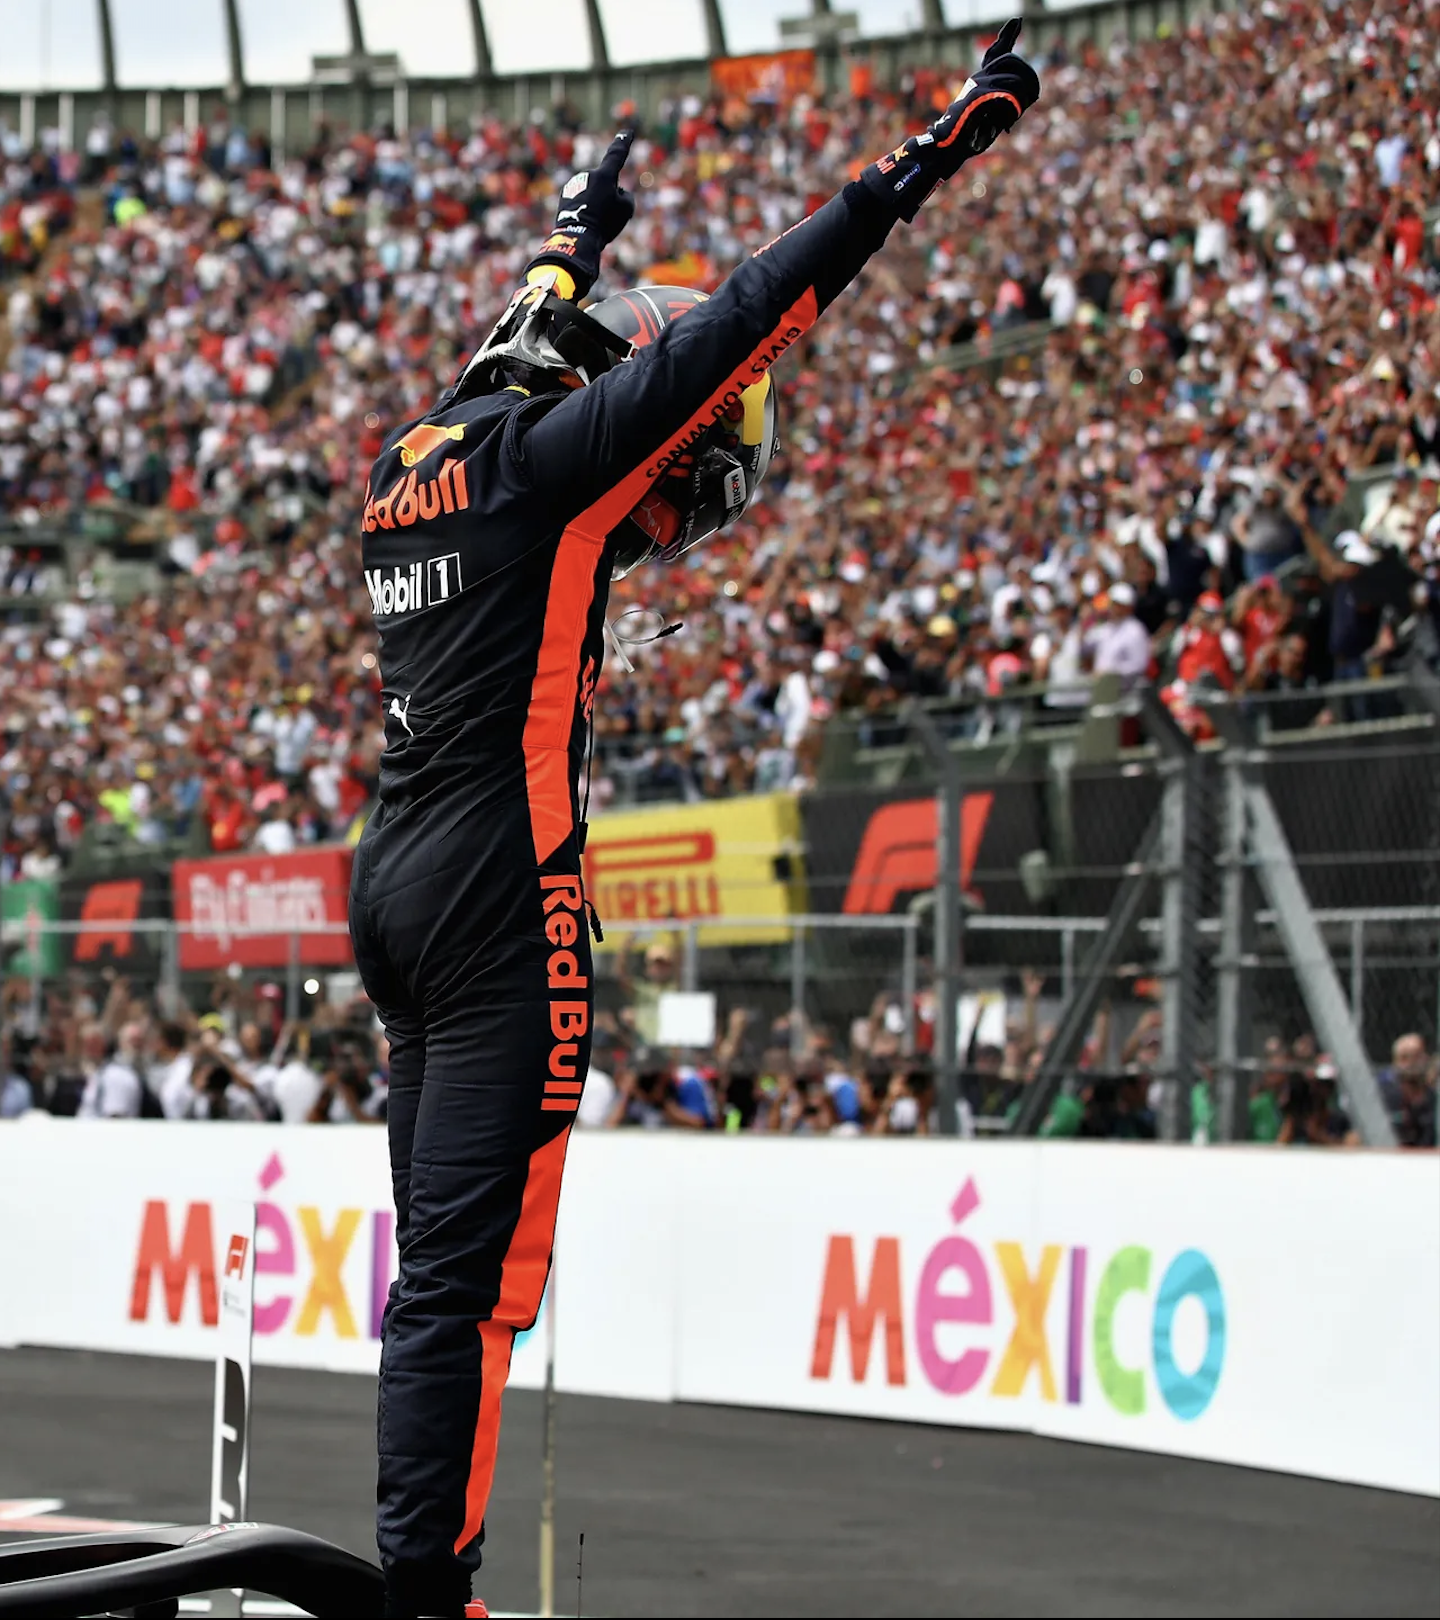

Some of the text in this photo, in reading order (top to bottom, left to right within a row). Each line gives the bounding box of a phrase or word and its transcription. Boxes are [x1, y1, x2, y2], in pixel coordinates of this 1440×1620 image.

[751, 326, 801, 374] GIVES
[645, 421, 709, 479] WINGS
[362, 458, 469, 533] ed Bull
[364, 562, 422, 616] Mobil
[583, 830, 724, 920] PIRELLI
[539, 875, 589, 1111] Red Bull
